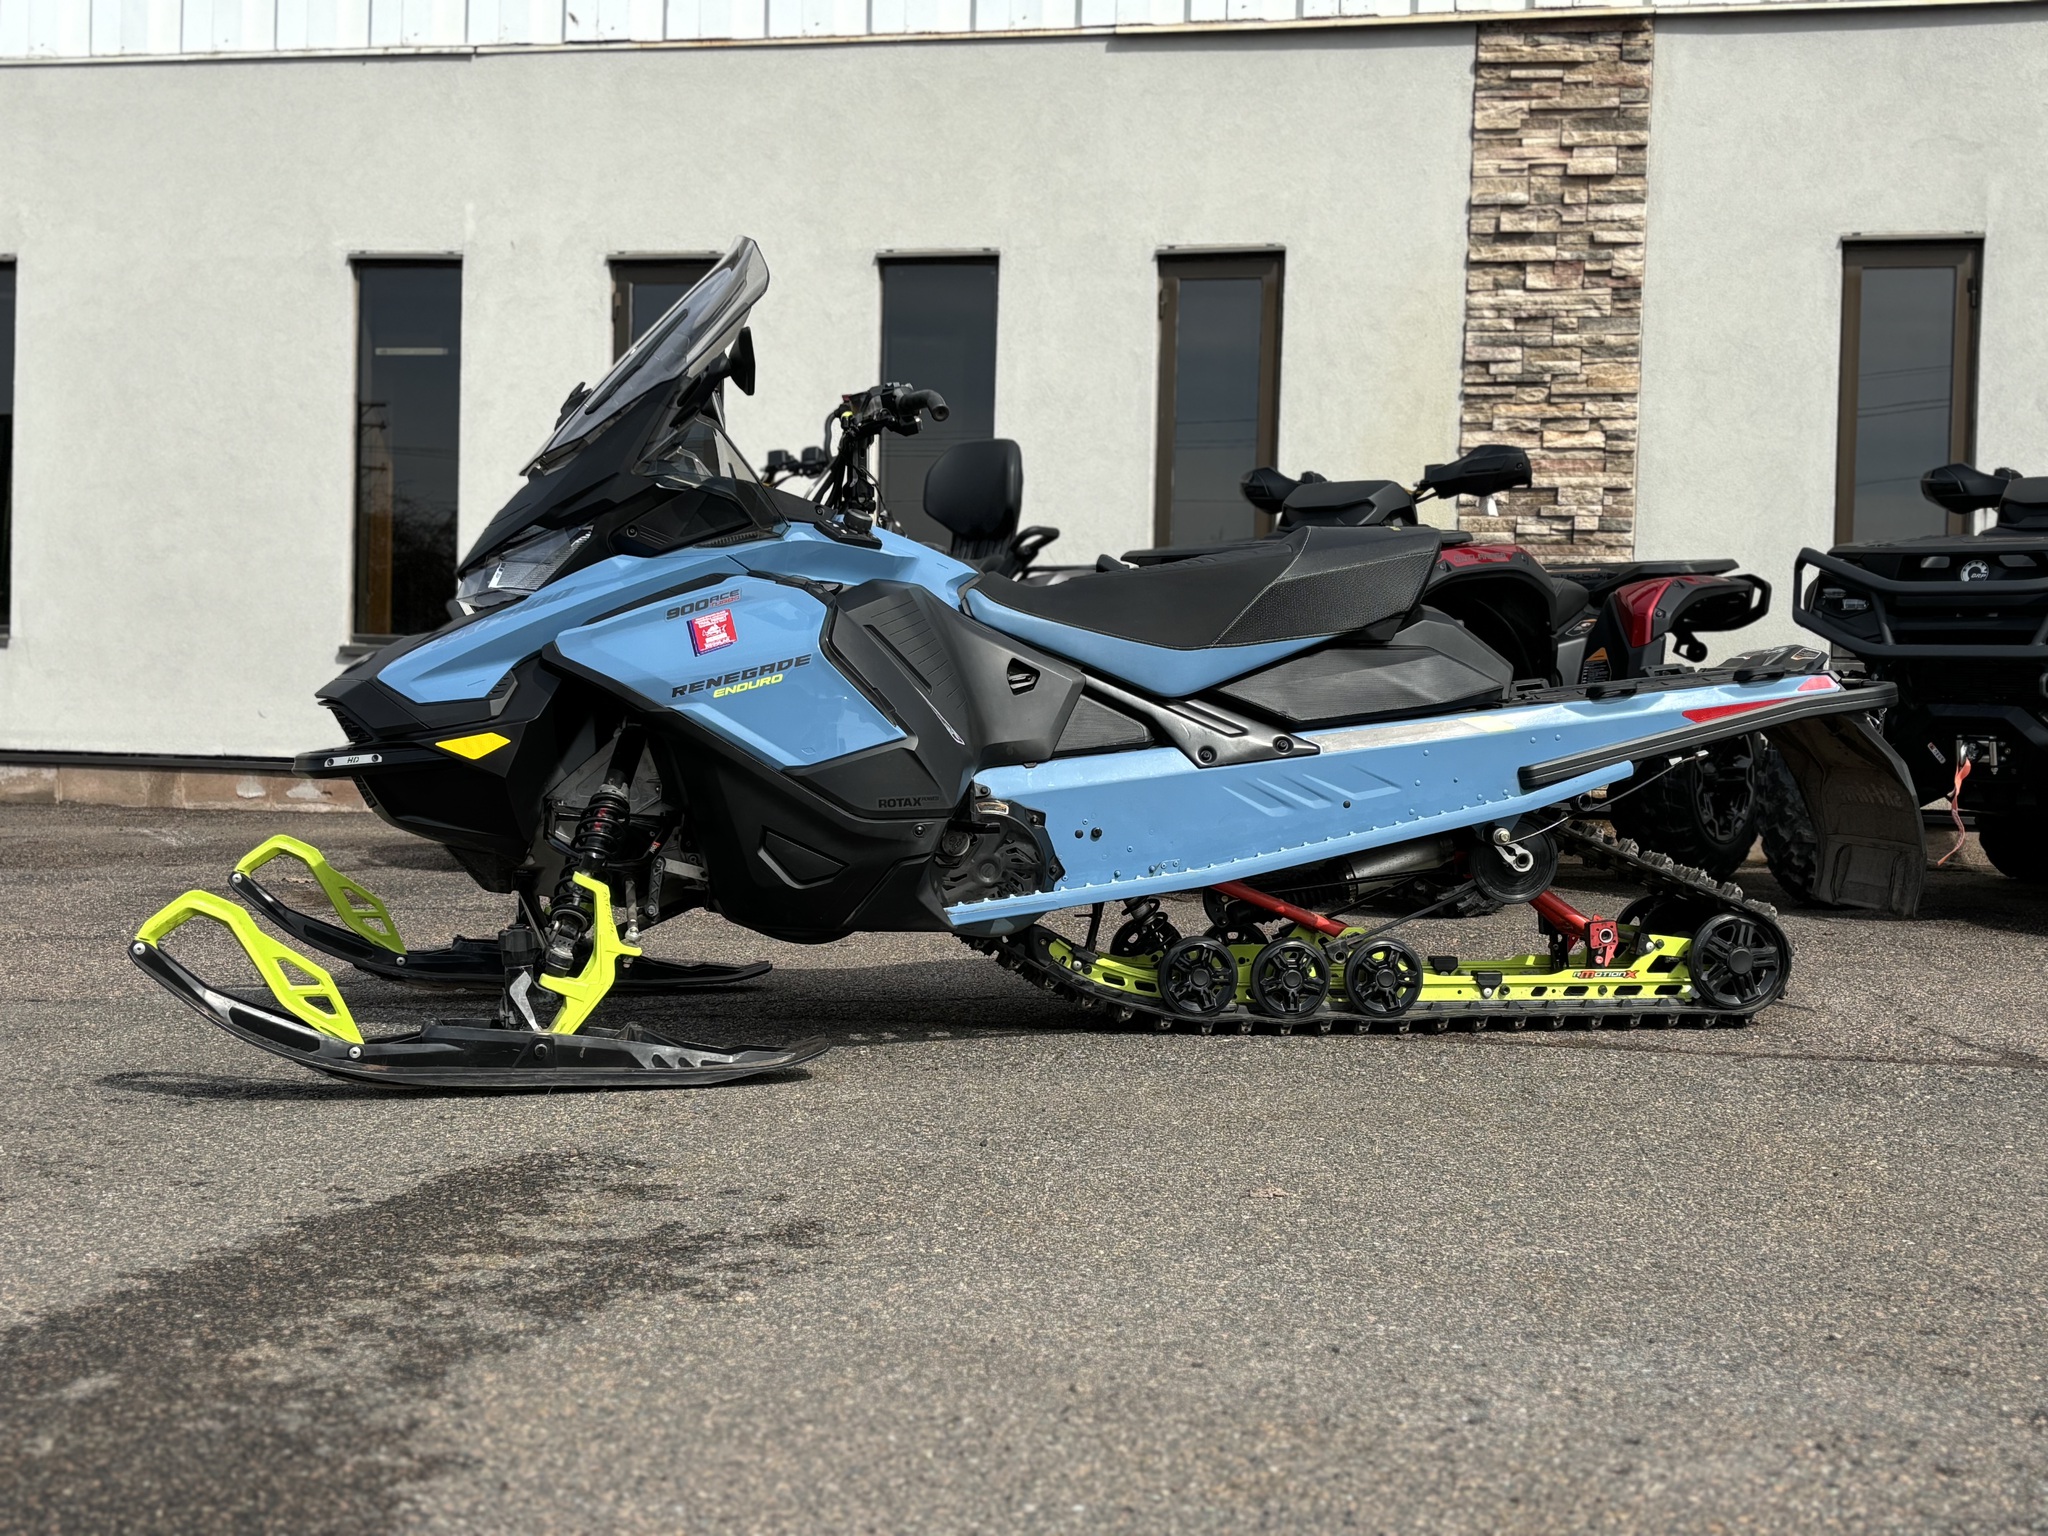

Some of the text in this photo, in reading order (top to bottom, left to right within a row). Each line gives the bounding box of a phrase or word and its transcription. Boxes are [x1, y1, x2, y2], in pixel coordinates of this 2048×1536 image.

[666, 598, 709, 620] 900
[709, 589, 740, 604] ACE
[671, 654, 812, 698] RENEGADE
[713, 673, 784, 698] ENDURO
[347, 756, 360, 764] HD
[878, 797, 922, 808] ROTAX
